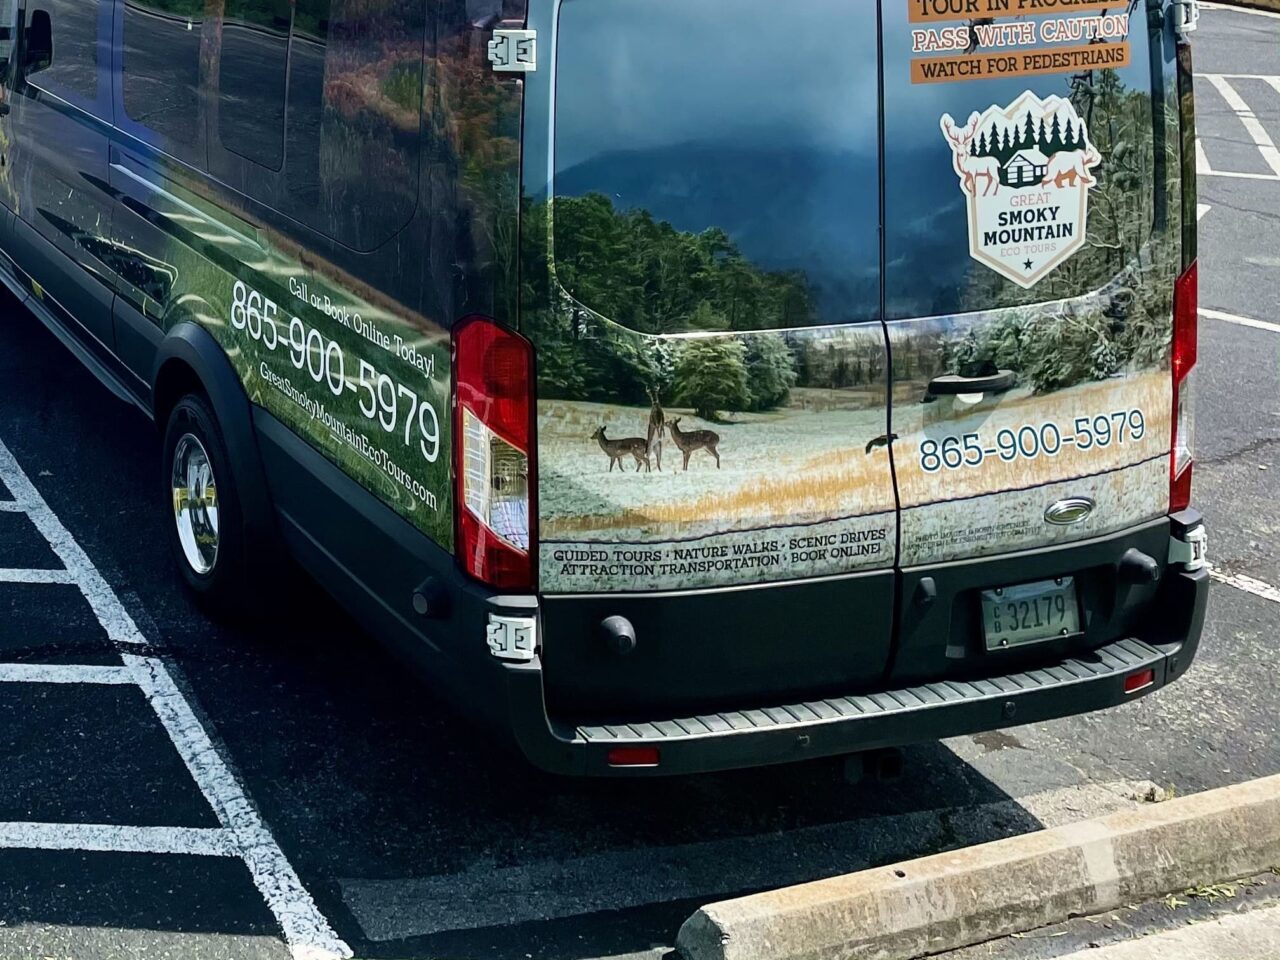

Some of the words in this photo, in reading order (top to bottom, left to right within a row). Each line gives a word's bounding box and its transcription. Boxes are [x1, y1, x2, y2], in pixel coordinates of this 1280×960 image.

[913, 29, 969, 51] PASS
[976, 23, 1036, 45] WITH
[1041, 16, 1128, 41] CAUTION
[921, 59, 982, 78] WATCH
[987, 56, 1018, 73] FOR
[1023, 47, 1124, 70] PEDESTRIANS
[1010, 192, 1051, 207] GREAT
[998, 206, 1060, 227] SMOKY
[983, 222, 1073, 246] MOUNTAIN
[1000, 246, 1021, 257] ECO
[1024, 243, 1057, 255] TOURS
[289, 276, 309, 304] Call
[310, 292, 322, 308] or
[323, 295, 351, 329] Book
[353, 313, 390, 351] Online
[393, 334, 436, 379] Today!
[230, 280, 440, 463] 865-900-5979
[260, 362, 438, 511] GreatSmokyMountainEcoTours.com
[920, 408, 1145, 473] 865-900-5979
[553, 550, 609, 562] GUIDED
[613, 549, 662, 562] TOURS
[673, 545, 728, 561] NATURE
[733, 541, 779, 556] WALKS
[789, 535, 837, 550] SCENIC
[840, 529, 887, 544] DRIVES
[560, 562, 655, 576] ATTRACTION
[660, 555, 780, 575] TRANSPORTATION
[791, 549, 827, 563] BOOK
[1007, 594, 1066, 632] 32179
